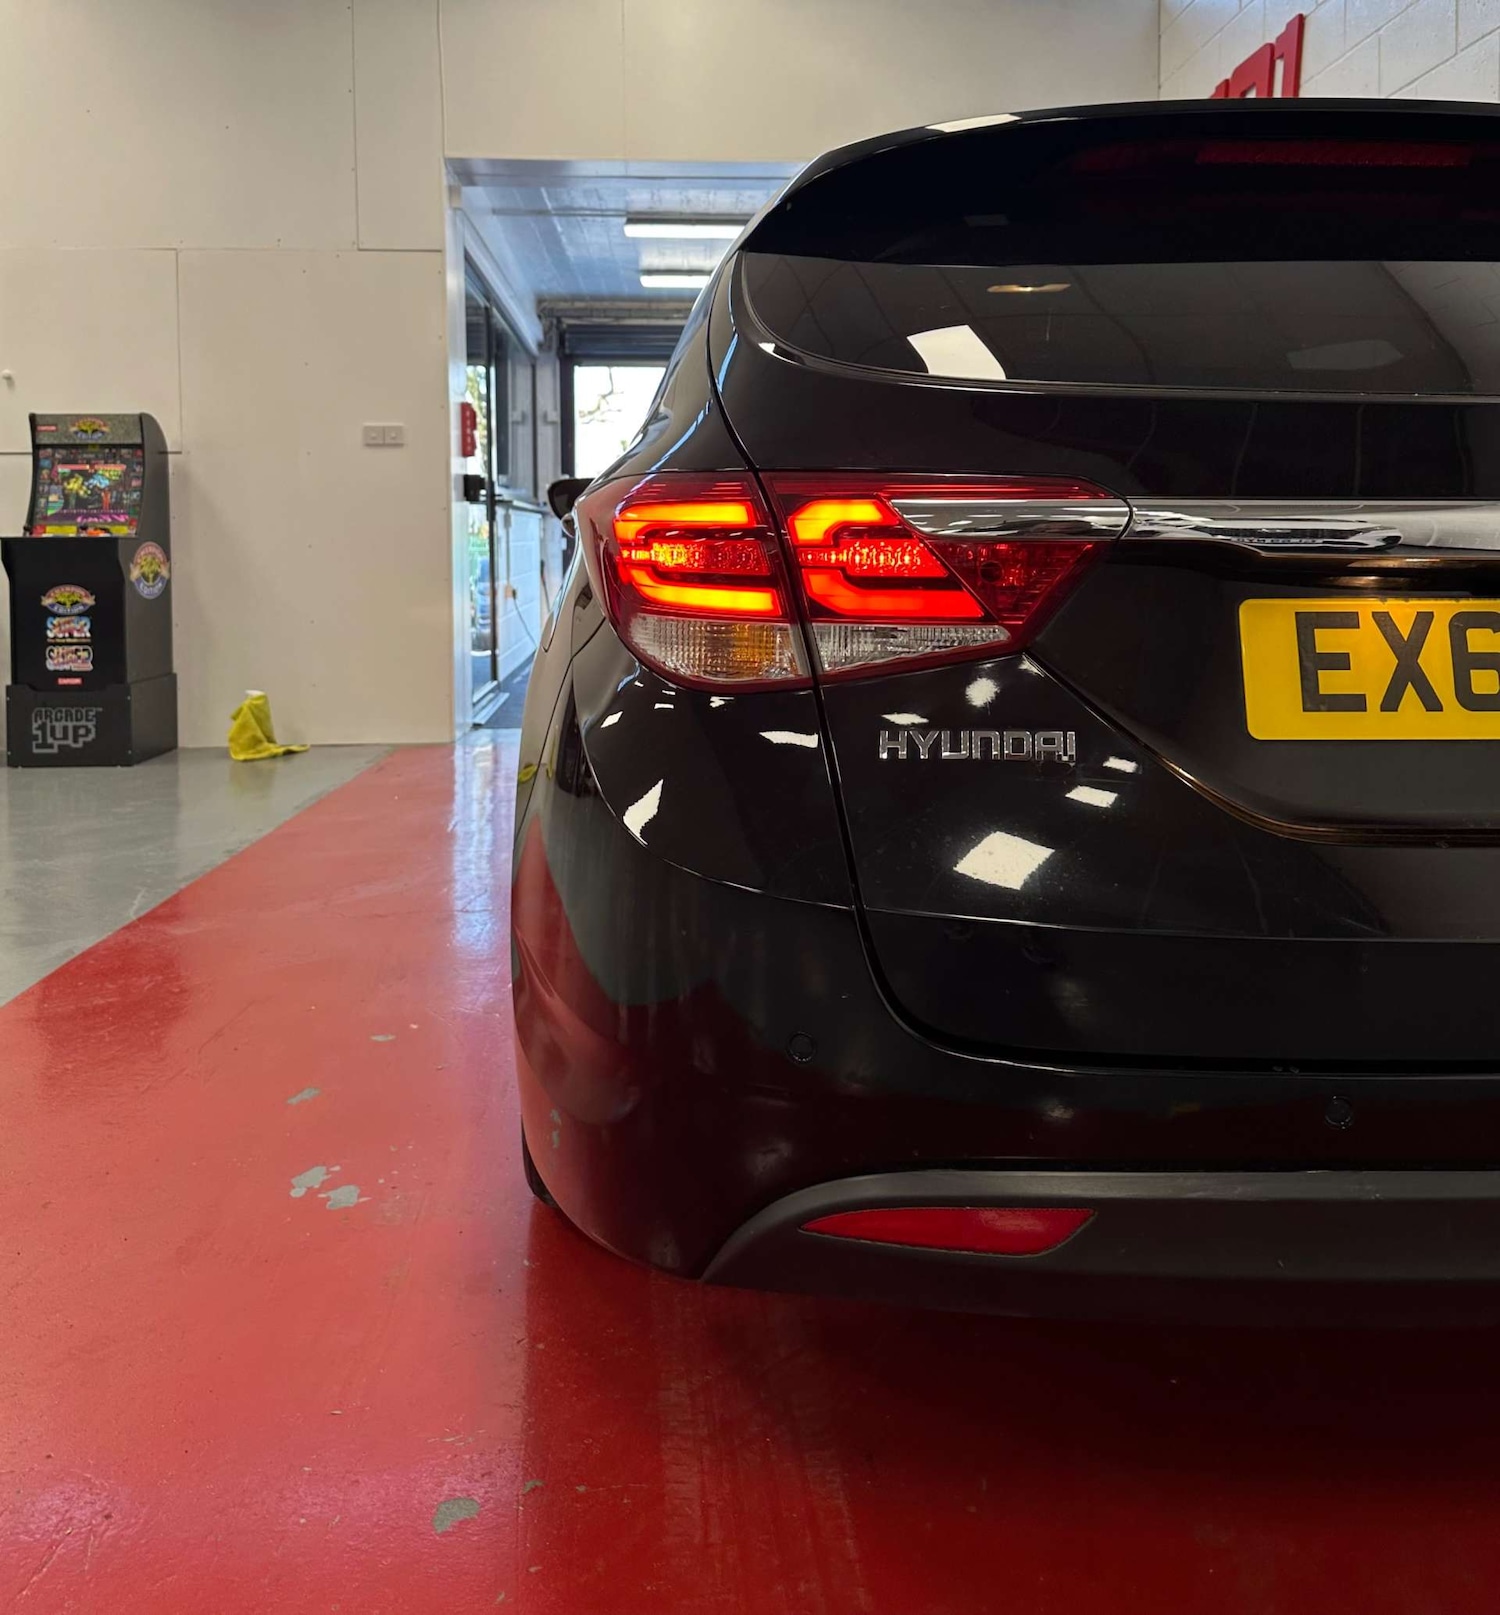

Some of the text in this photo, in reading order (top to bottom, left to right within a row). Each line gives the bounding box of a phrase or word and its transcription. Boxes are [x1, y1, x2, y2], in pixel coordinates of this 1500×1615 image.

[1295, 611, 1500, 712] EX6
[33, 707, 96, 724] ARCADE
[878, 730, 1076, 761] HYUNDAI
